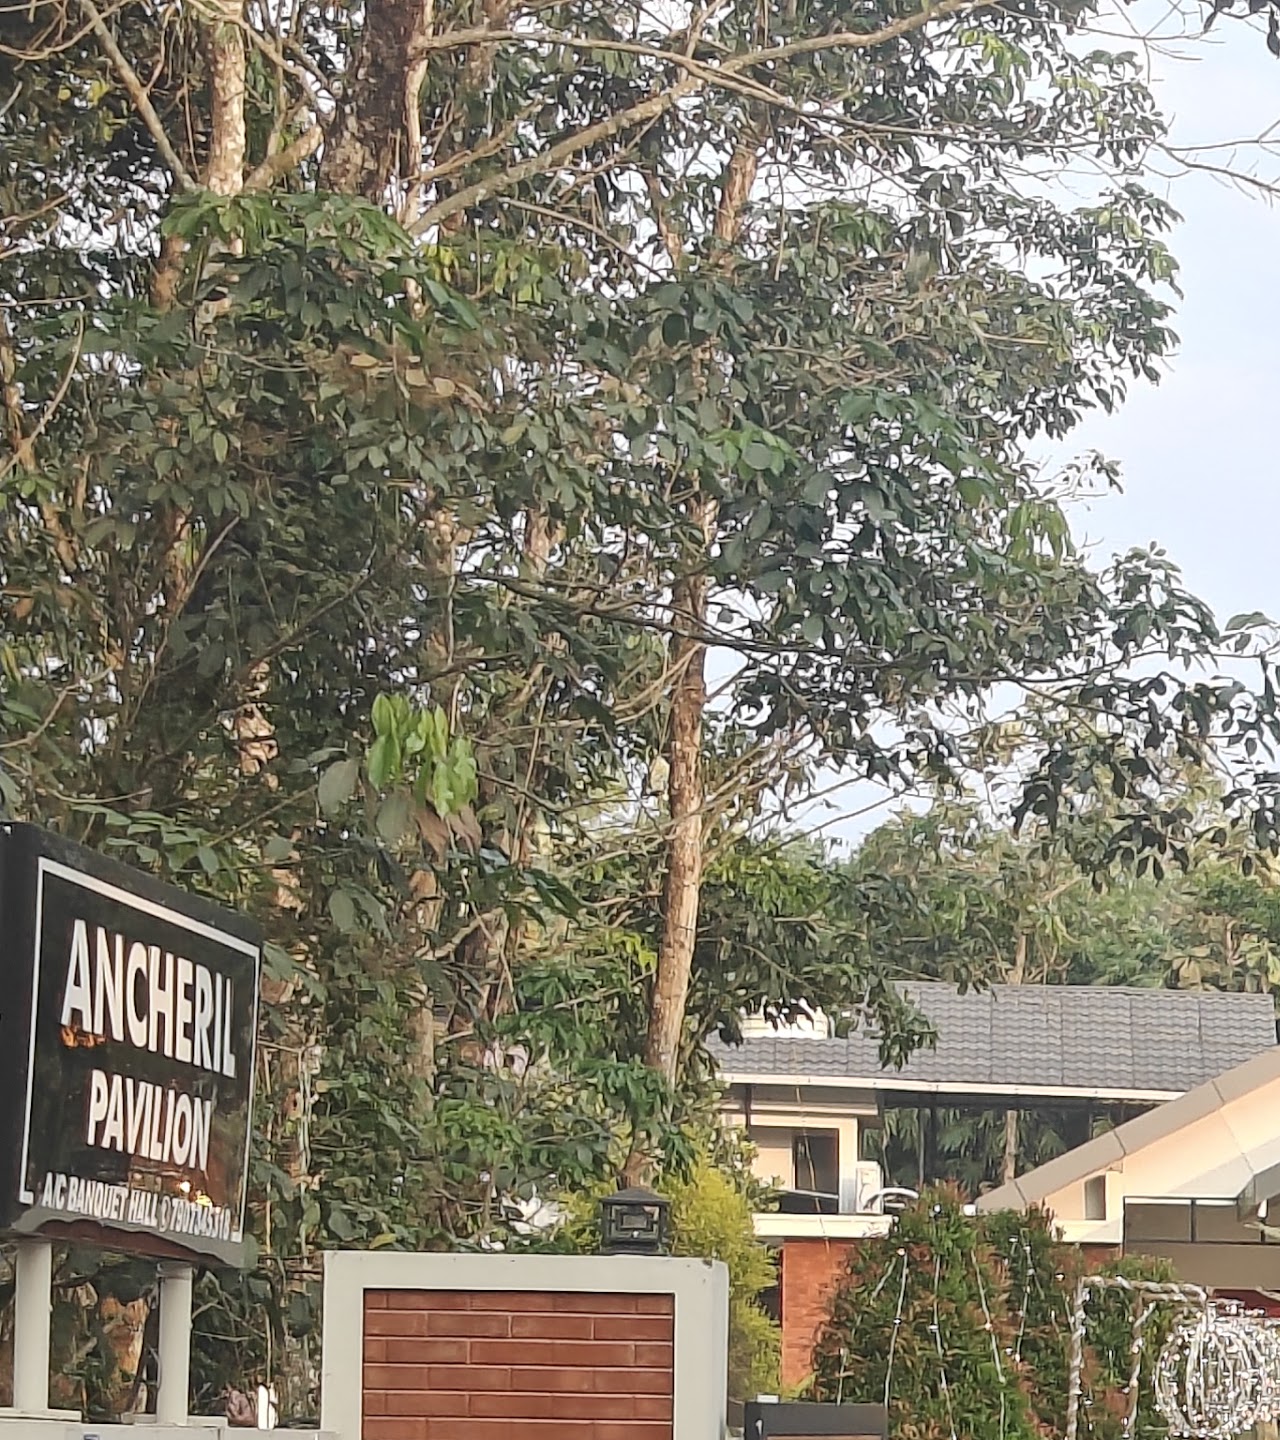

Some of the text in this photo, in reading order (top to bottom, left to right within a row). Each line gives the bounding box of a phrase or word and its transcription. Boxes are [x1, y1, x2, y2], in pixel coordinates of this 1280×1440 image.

[60, 918, 236, 1079] ANCHERIL
[86, 1068, 212, 1172] PAVILION
[67, 1176, 128, 1221] BANQUET
[128, 1189, 158, 1227] HALL
